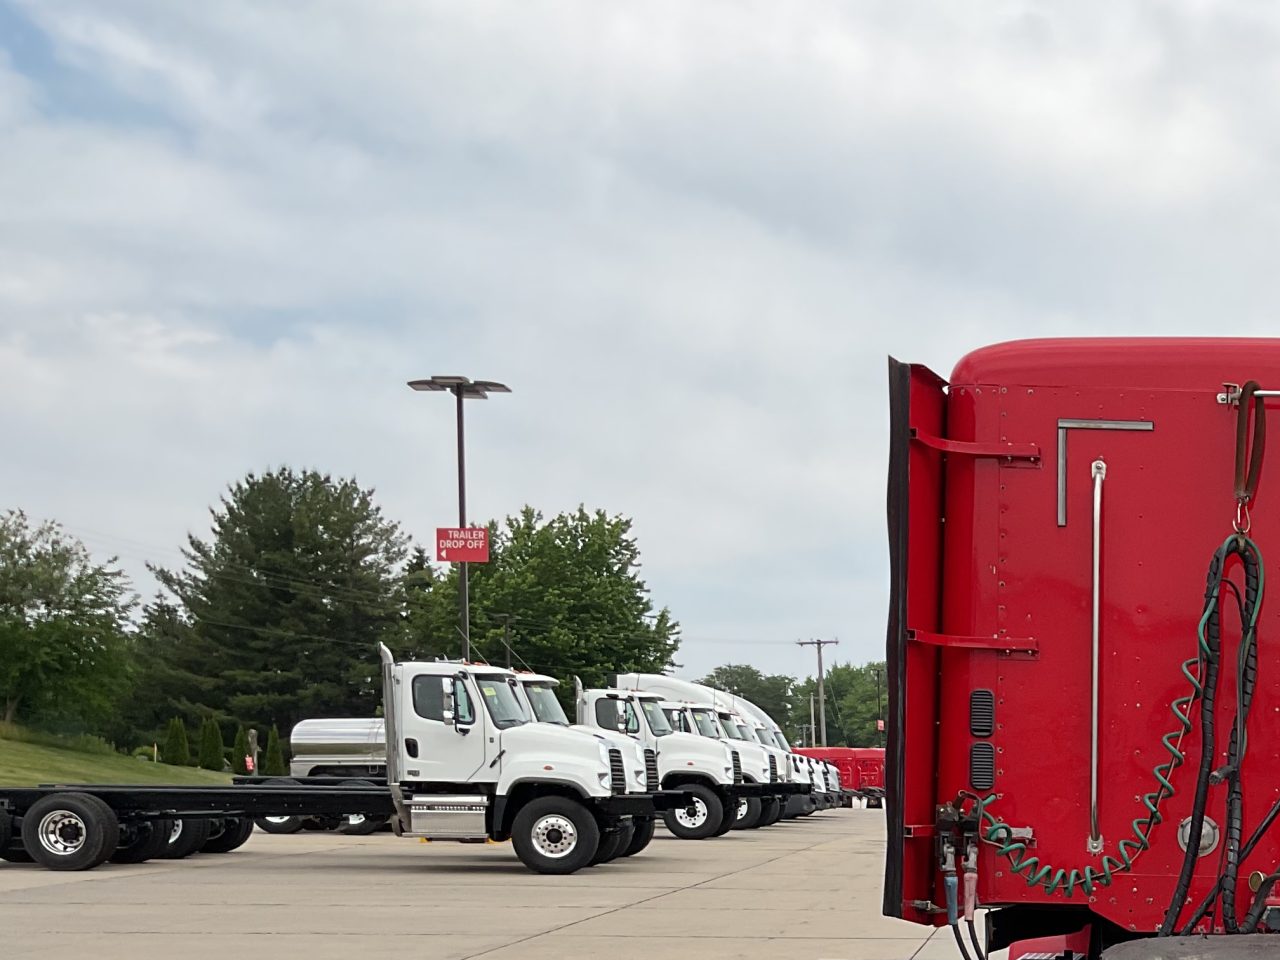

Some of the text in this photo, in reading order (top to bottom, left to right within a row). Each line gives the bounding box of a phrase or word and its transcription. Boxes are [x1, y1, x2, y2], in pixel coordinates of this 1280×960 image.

[448, 530, 485, 539] TRAILER
[440, 540, 485, 549] DROP OFF
